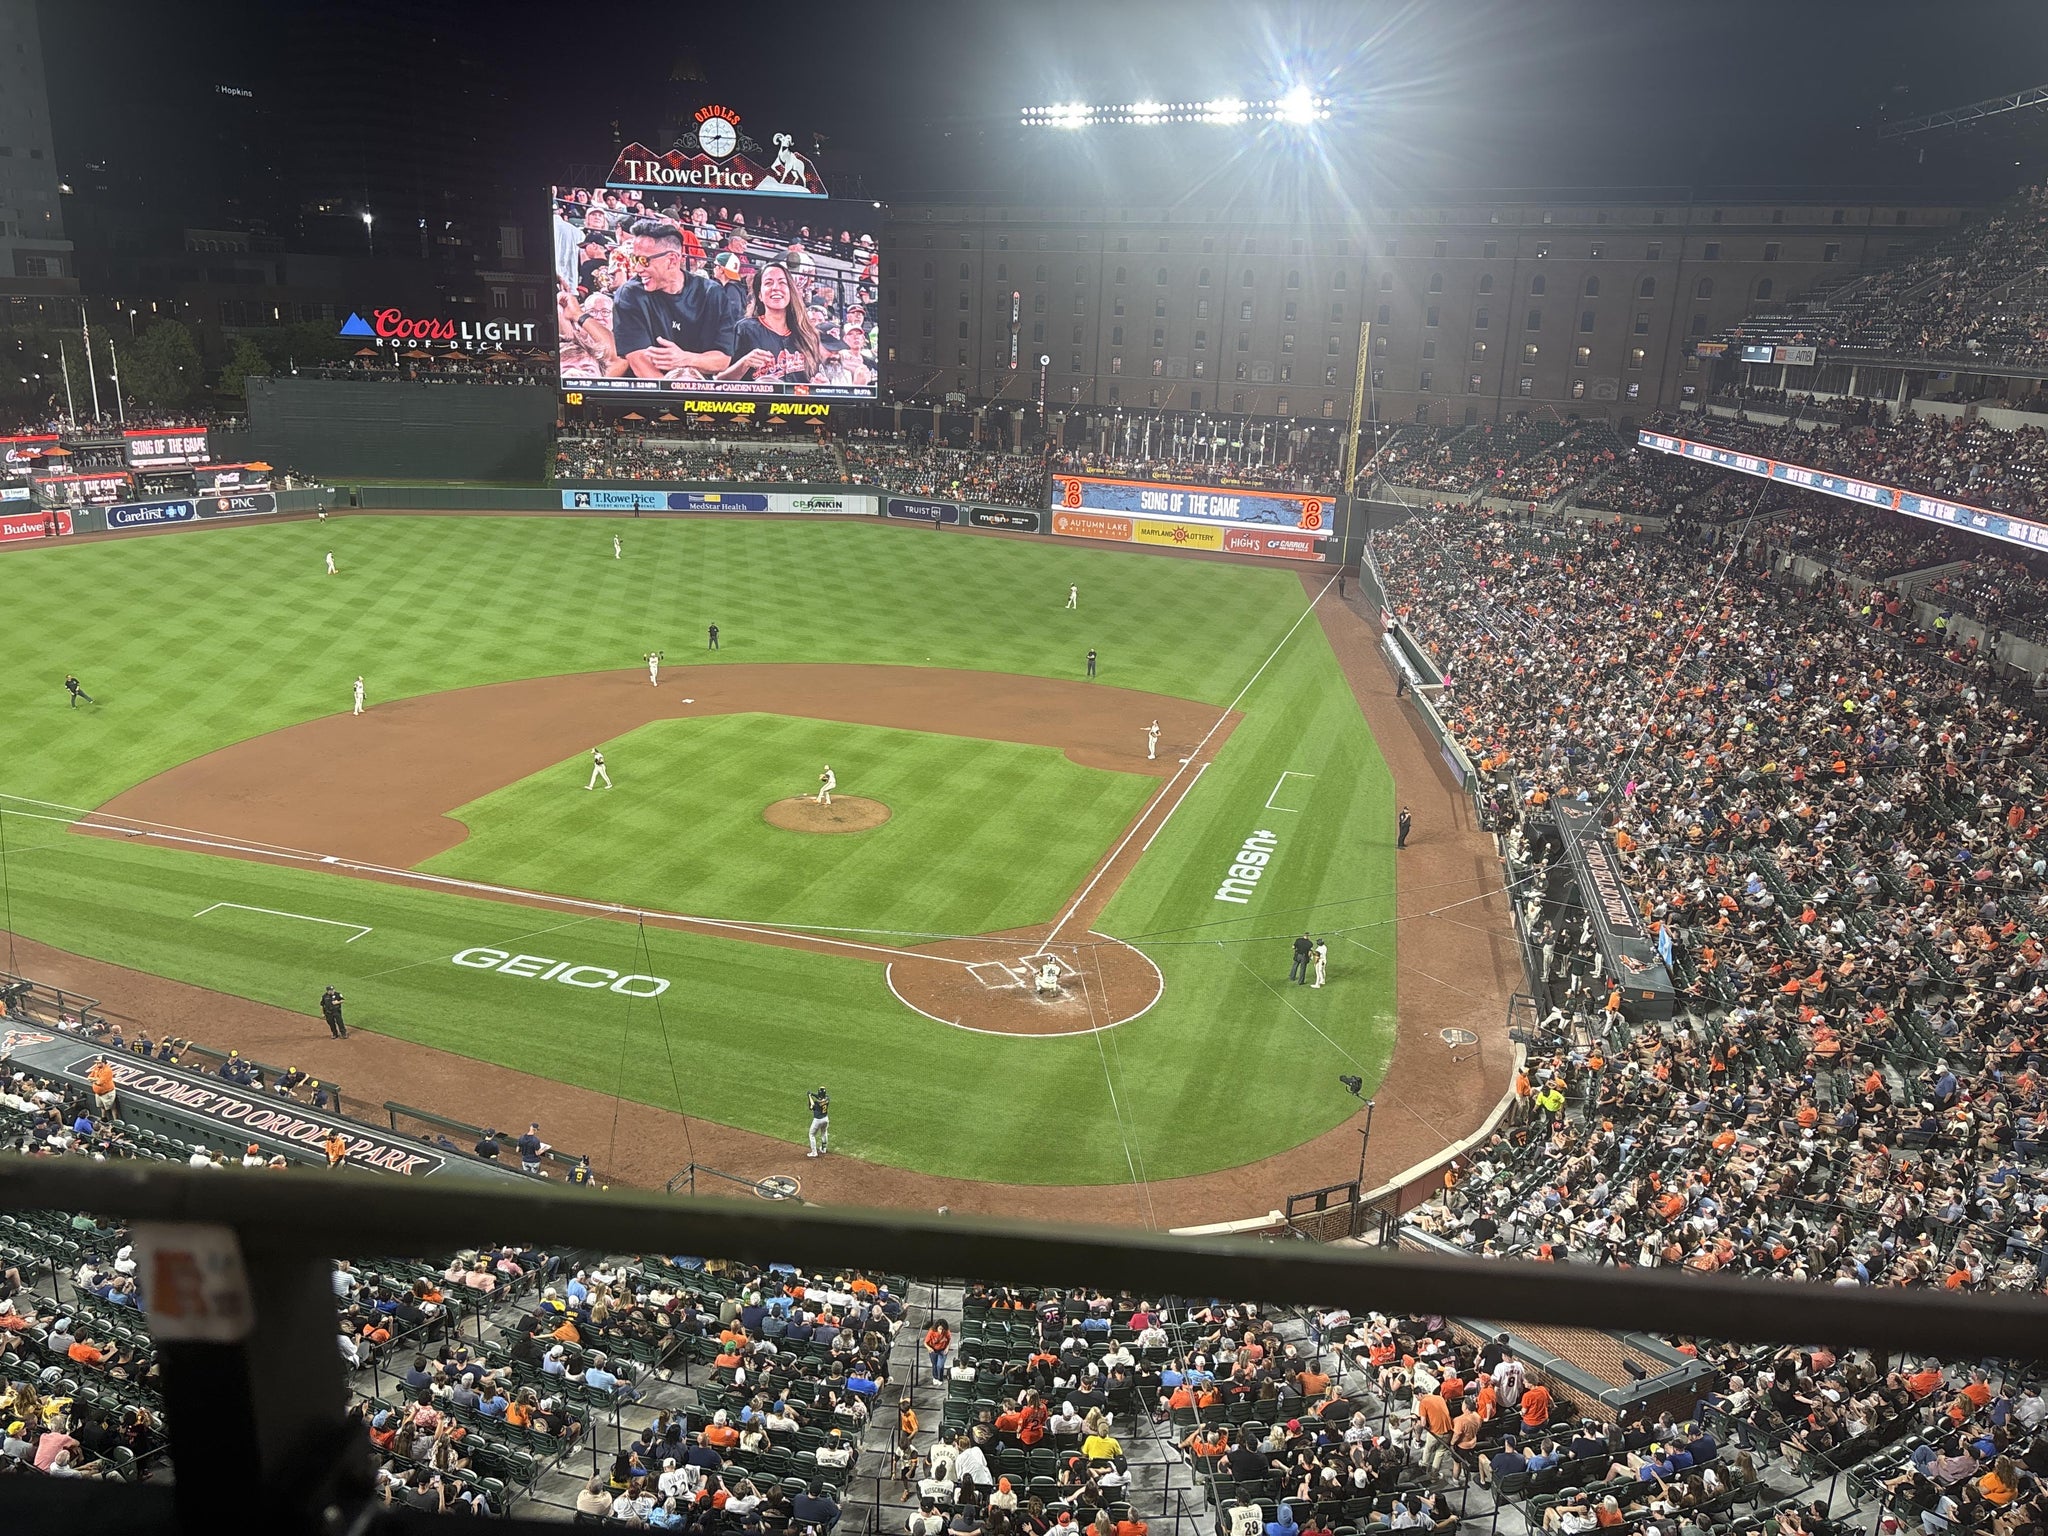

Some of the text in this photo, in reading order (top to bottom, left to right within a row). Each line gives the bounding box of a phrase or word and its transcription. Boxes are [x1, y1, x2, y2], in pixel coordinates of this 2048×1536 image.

[221, 85, 253, 97] Hopkins
[694, 104, 742, 126] ORIOLES
[703, 164, 753, 187] Price
[373, 308, 536, 342] Coors LIGHT
[376, 338, 503, 351] ROOF DECK
[670, 382, 697, 390] ORIOLE
[698, 383, 715, 391] PARK
[722, 384, 752, 392] CAMDEN
[752, 384, 774, 393] YARDS
[684, 400, 830, 416] PUREWAGER PAVILION
[132, 440, 154, 456] SONG
[155, 440, 165, 454] OF
[168, 438, 184, 453] THE
[231, 498, 255, 508] PNC
[722, 503, 747, 511] Health
[1141, 491, 1241, 518] SONG OF THE GAME
[116, 508, 166, 523] CareFirst
[904, 506, 930, 515] TRUIST
[1070, 519, 1128, 531] AUTUMN LAKE
[1142, 528, 1174, 537] MARYLAND
[1230, 537, 1260, 551] HIGH'S
[1280, 540, 1310, 549] CARROLL
[452, 947, 671, 998] GEICO
[204, 1097, 253, 1120] TO
[346, 1138, 430, 1176] PARK
[1508, 1376, 1515, 1388] 8
[670, 1481, 688, 1497] 22
[1244, 1520, 1259, 1535] 29
